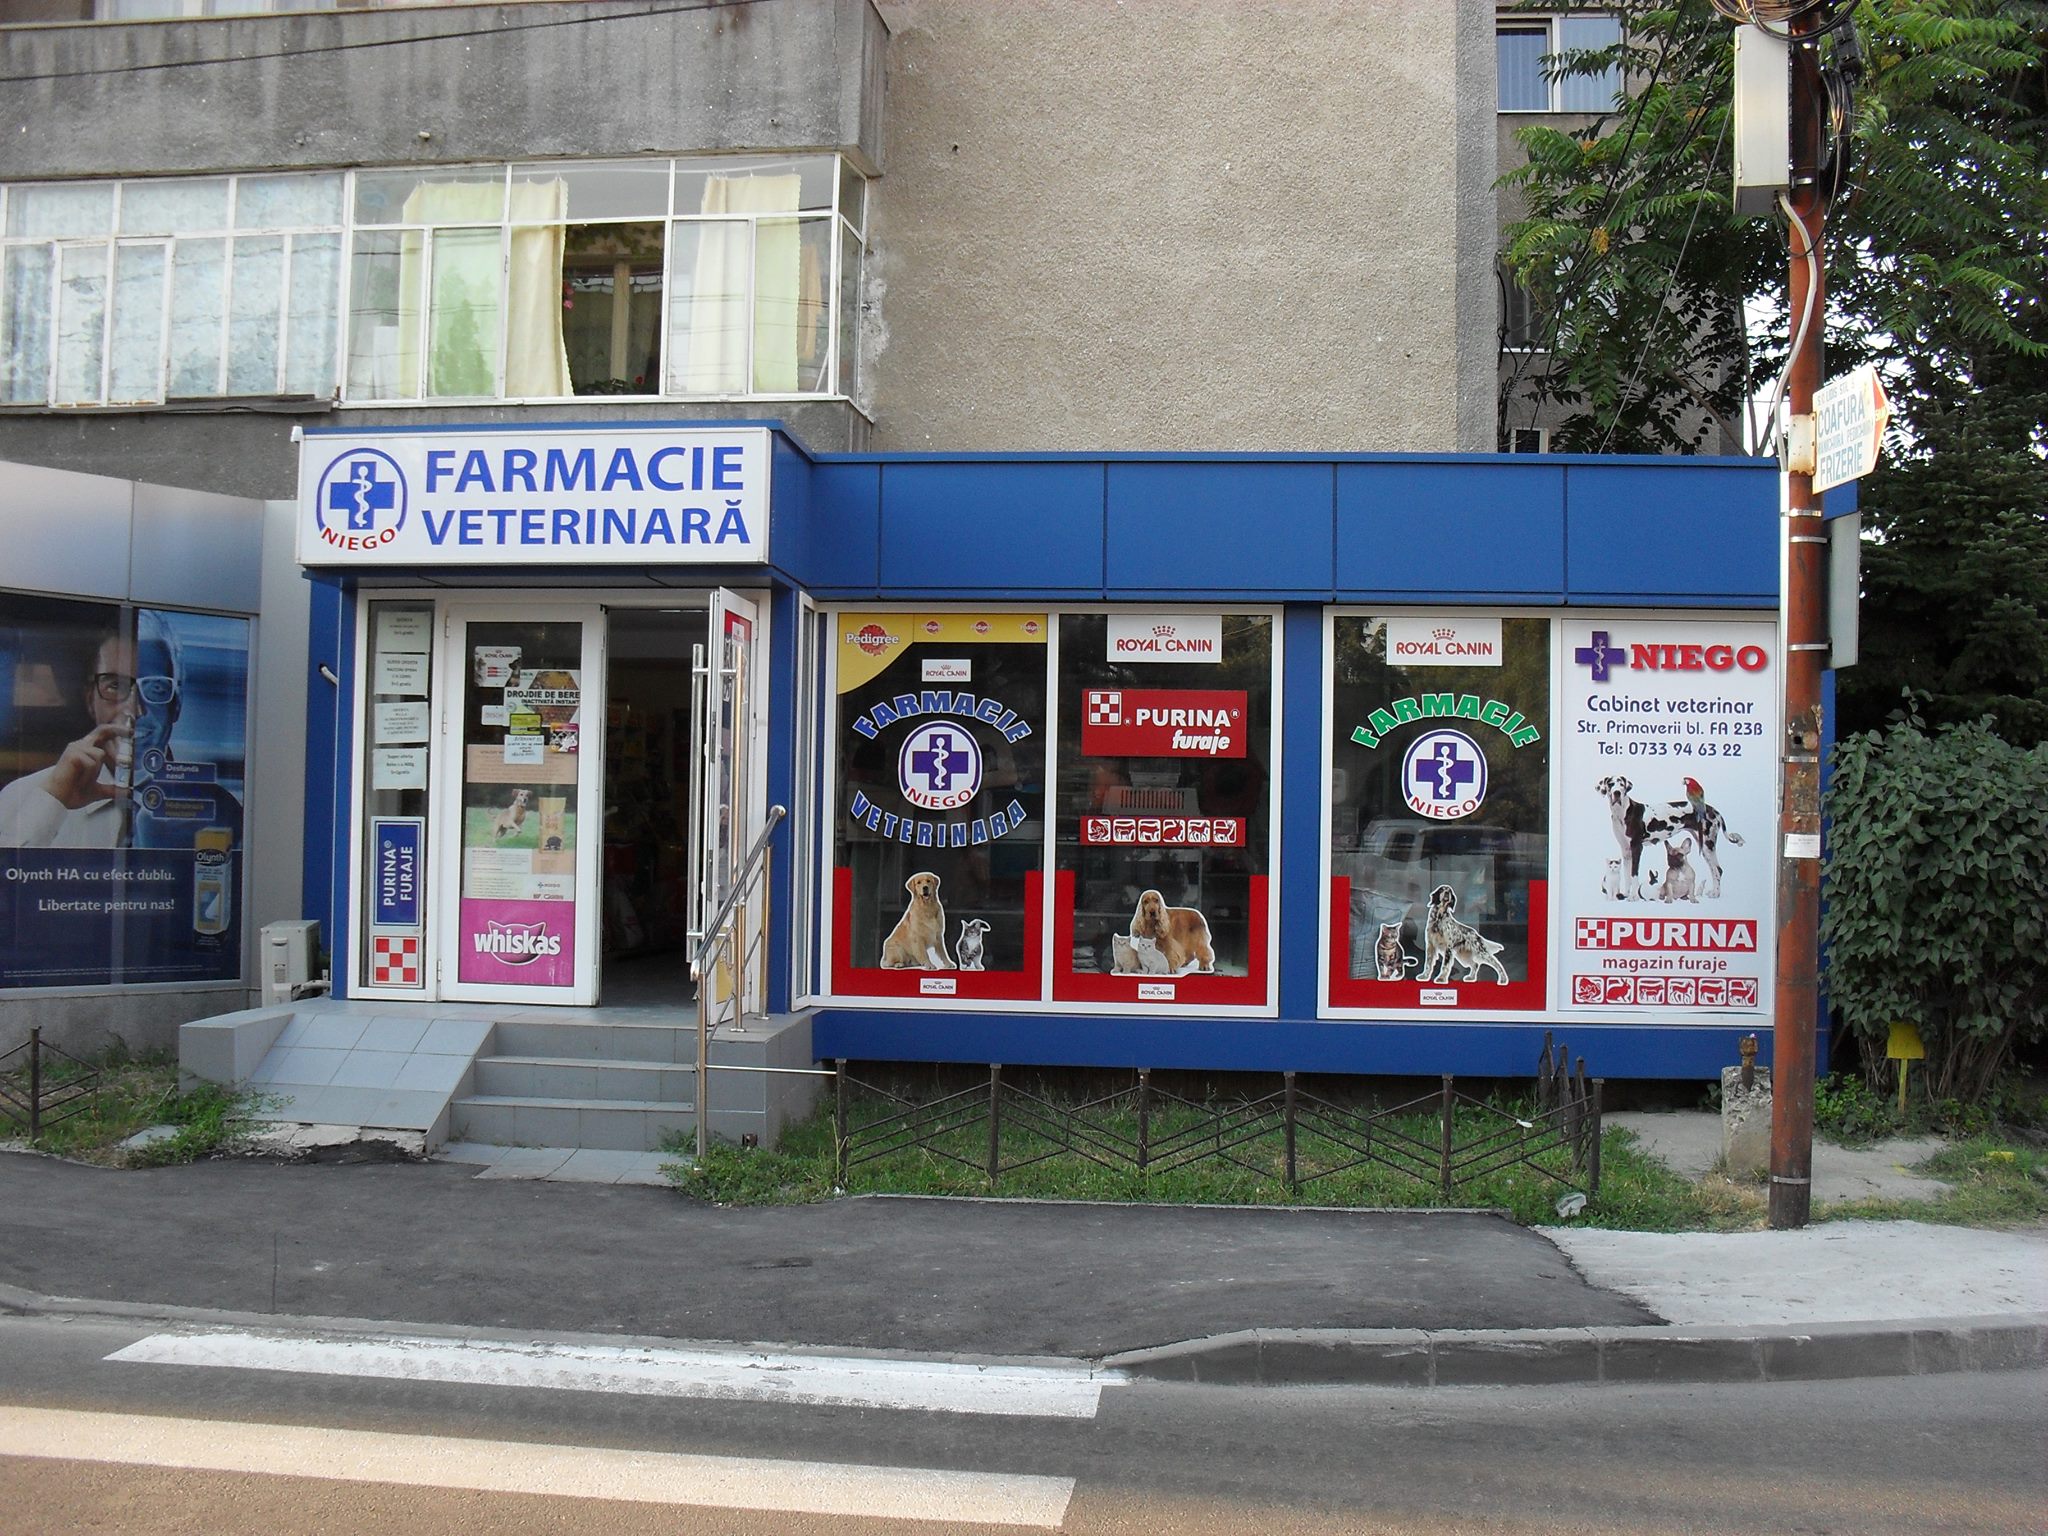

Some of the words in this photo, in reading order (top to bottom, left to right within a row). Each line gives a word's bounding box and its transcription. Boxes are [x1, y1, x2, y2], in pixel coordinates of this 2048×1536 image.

[1817, 390, 1865, 438] COAFURA
[425, 446, 744, 493] FARMACIE
[1820, 441, 1863, 486] FRIZERIE
[421, 499, 751, 546] VETERINARĂ
[321, 527, 396, 551] NIEGO
[846, 633, 899, 646] Pedigree
[1116, 639, 1161, 651] ROYAL
[1165, 639, 1212, 652] CANIN
[1396, 642, 1442, 655] ROYAL
[1445, 642, 1493, 655] CANIN
[1630, 643, 1768, 672] NIEGO
[506, 690, 541, 698] DROJDIE
[558, 691, 580, 699] BERE
[1587, 695, 1660, 713] Cabinet
[1666, 697, 1754, 714] veterinar
[852, 690, 1032, 744] FARMACIE
[1350, 693, 1540, 749] FARMACIE
[1577, 720, 1600, 734] Str.
[1606, 720, 1681, 735] Primaverii
[1687, 721, 1704, 735] bl.
[1710, 722, 1729, 735] FA
[1172, 728, 1231, 755] furaje
[1598, 741, 1623, 755] Tel:
[1628, 742, 1668, 755] 0733
[1673, 743, 1692, 756] 94
[1698, 743, 1717, 756] 63
[1722, 743, 1742, 757] 22
[150, 756, 156, 768] 1
[907, 788, 972, 807] NIEGO
[1410, 796, 1476, 817] NIEGO
[850, 790, 1027, 848] VETERINARA
[5, 868, 53, 883] Olynth
[57, 868, 80, 880] HA
[83, 871, 99, 880] cu
[102, 868, 134, 881] efect
[137, 869, 176, 881] dublu.
[400, 846, 413, 901] FURAJE
[38, 899, 101, 911] Libertate
[104, 900, 147, 914] pentru
[150, 899, 175, 910] nas!
[474, 928, 561, 955] whiskas
[1611, 921, 1754, 948] PURINA
[1603, 956, 1673, 972] magazin
[1678, 956, 1728, 973] furaje
